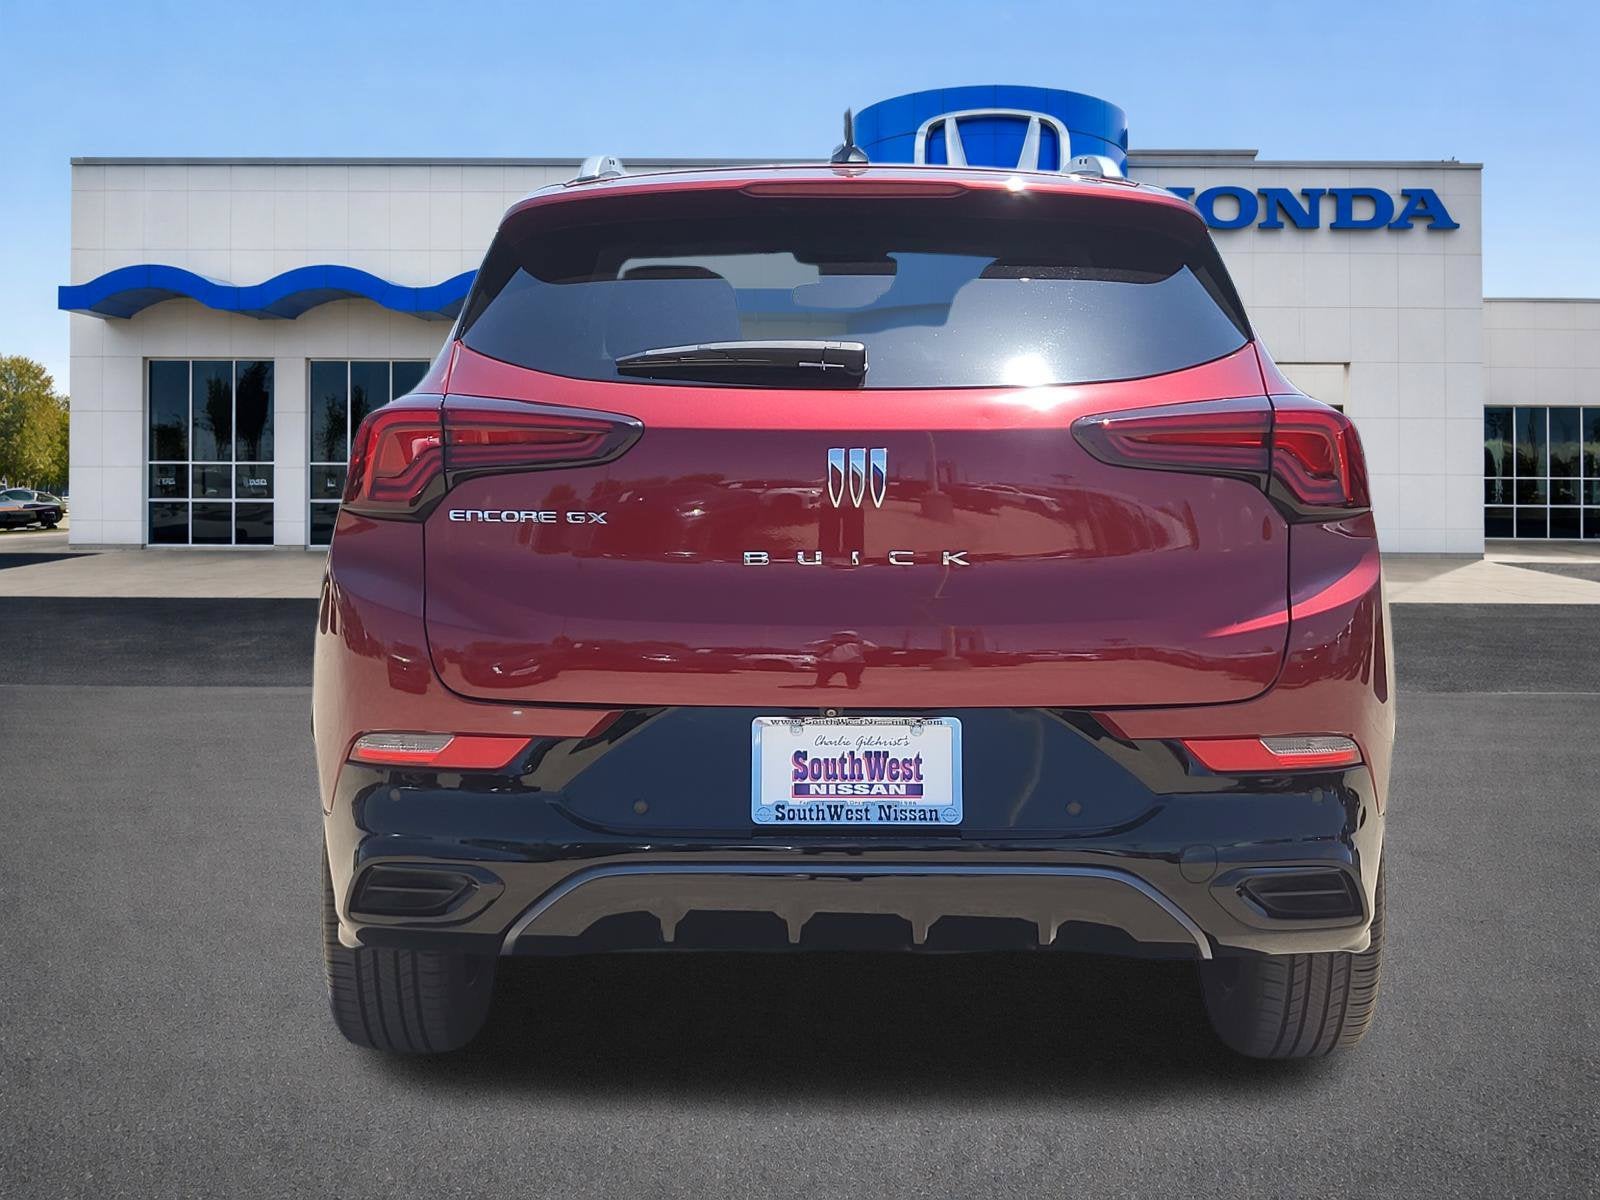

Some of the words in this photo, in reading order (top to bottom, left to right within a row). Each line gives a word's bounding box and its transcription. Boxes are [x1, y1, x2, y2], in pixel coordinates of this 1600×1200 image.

[449, 509, 557, 523] ENCORE
[566, 511, 608, 524] GX
[743, 551, 970, 566] BUICK
[814, 735, 852, 747] Charlie
[855, 735, 910, 751] Gilchrist's
[792, 750, 924, 782] SouthWest
[809, 784, 907, 795] NISSAN
[775, 804, 870, 821] SouthWest
[878, 804, 940, 821] Nissan
